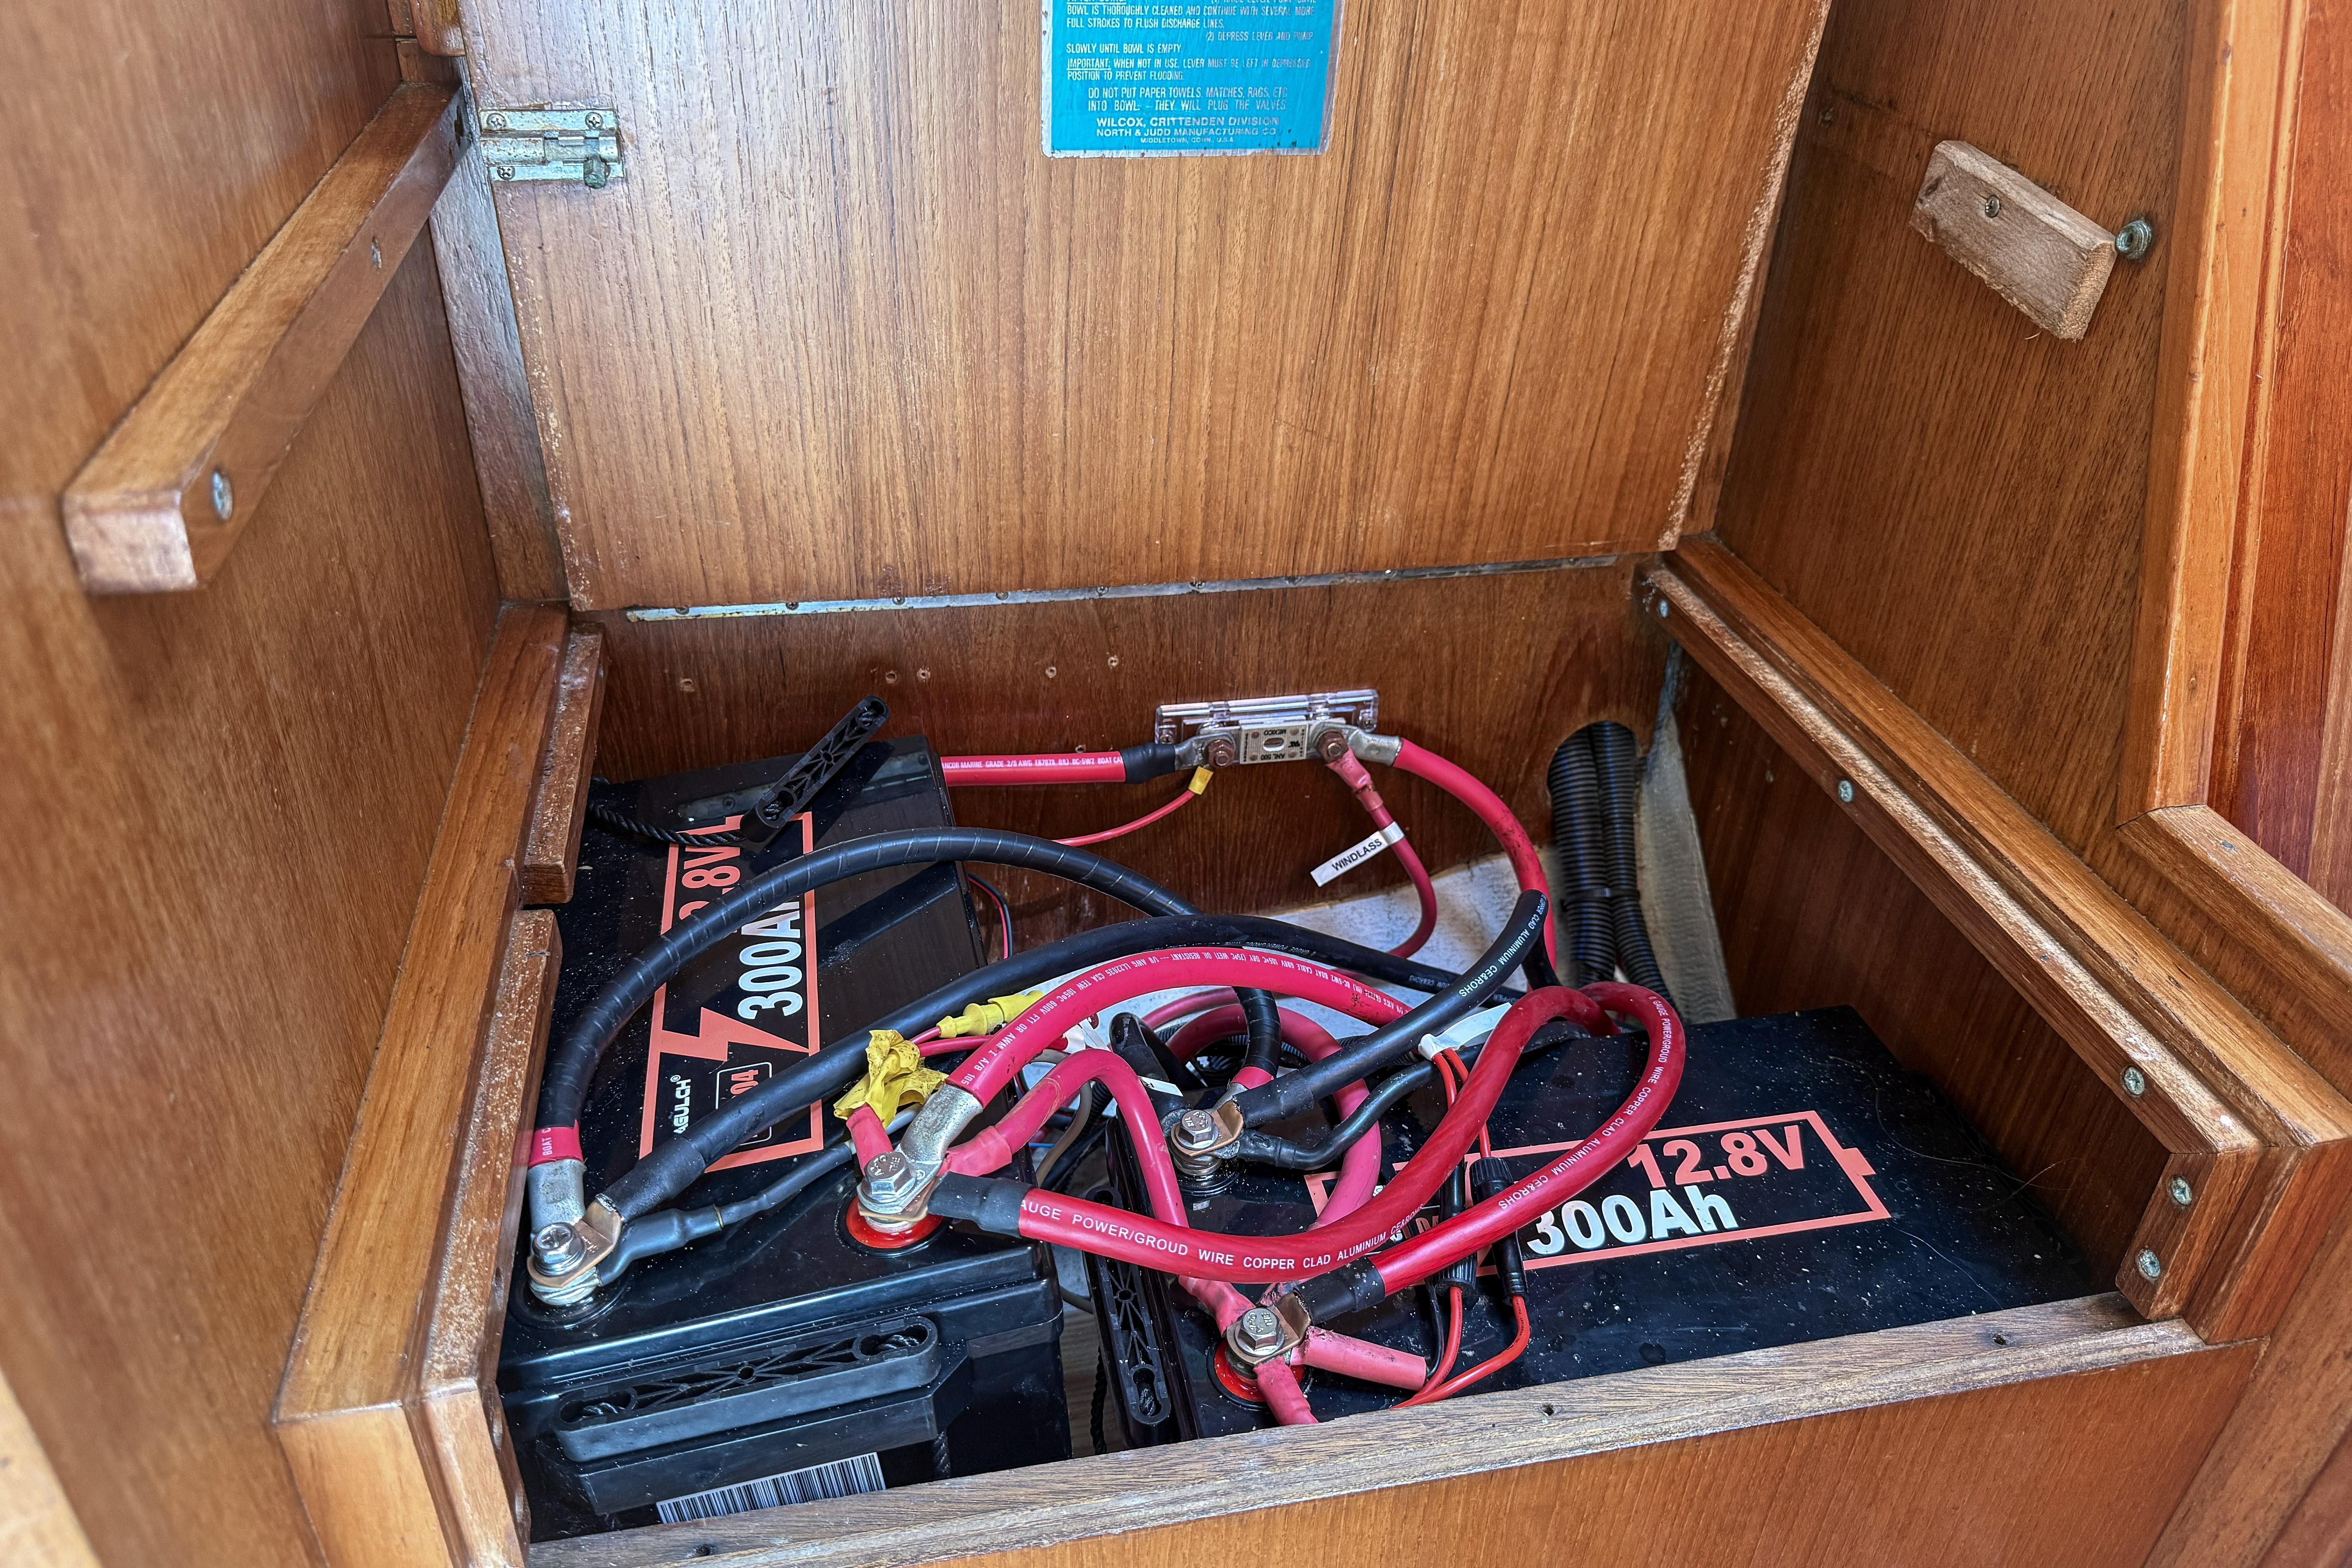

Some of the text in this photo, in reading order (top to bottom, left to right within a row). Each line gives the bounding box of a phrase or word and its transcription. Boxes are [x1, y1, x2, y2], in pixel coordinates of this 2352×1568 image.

[1067, 5, 1089, 15] BOWL
[1092, 5, 1099, 15] IS
[1103, 5, 1149, 15] THOROUGHLY
[1152, 5, 1183, 16] CLEANED
[1186, 6, 1200, 16] AND
[1203, 6, 1236, 16] CONTINUE
[1240, 6, 1258, 16] WITH
[1261, 6, 1290, 16] SEVERAL
[1067, 18, 1084, 28] FULL
[1087, 18, 1120, 28] STROKES
[1124, 18, 1132, 28] TO
[1135, 18, 1158, 28] FLUSH
[1162, 18, 1200, 28] DISCHARGE
[1206, 31, 1214, 42] (2)
[1218, 31, 1249, 41] DEPRESS
[1252, 31, 1273, 41] LEVER
[1276, 31, 1290, 41] AND
[1066, 43, 1096, 54] SLOWLY
[1099, 43, 1120, 54] UNTIL
[1123, 43, 1143, 54] BOWL
[1147, 43, 1154, 54] IS
[1067, 58, 1111, 69] IMPORTANT:
[1113, 58, 1134, 68] WHEN
[1137, 58, 1151, 68] NOT
[1154, 58, 1161, 68] IN
[1183, 58, 1205, 68] LEVER
[1208, 58, 1227, 68] MUST
[1231, 58, 1239, 68] BE
[1243, 58, 1258, 68] LEFT
[1067, 71, 1100, 81] POSITION
[1104, 71, 1112, 81] TO
[1115, 71, 1146, 81] PREVENT
[1088, 87, 1099, 98] DO
[1102, 87, 1118, 98] NOT
[1121, 87, 1137, 98] PUT
[1139, 87, 1166, 98] PAPER
[1088, 100, 1107, 111] INTO
[1155, 100, 1175, 111] THEY
[1181, 100, 1201, 111] WILL
[1208, 100, 1228, 110] PLUG
[1235, 99, 1249, 110] THE
[1256, 99, 1286, 110] VALVES
[1097, 117, 1279, 128] WILCOX, CRITTENDEN DIVISION
[1174, 128, 1258, 136] MANUFACTURING
[1331, 837, 1383, 872] WINDLASS
[1528, 914, 1540, 930] CLAD
[1498, 929, 1530, 965] ALUMINIUM
[738, 901, 803, 1020] 300A
[1170, 952, 1201, 961] RESISTANT
[1131, 959, 1147, 968] AWG
[1091, 972, 1105, 982] CSA
[1315, 969, 1329, 980] BOAT
[1459, 965, 1498, 997] CE&ROHS
[1076, 979, 1092, 991] TEW
[1039, 1000, 1058, 1015] 600V
[1652, 1000, 1668, 1017] GAUGE
[1026, 1013, 1041, 1024] FT1
[1015, 1023, 1028, 1034] OR
[996, 1032, 1016, 1050] AWM
[1658, 1018, 1671, 1063] POWER/GROUD
[961, 1073, 976, 1085] 105
[1647, 1066, 1664, 1084] WIRE
[1623, 1087, 1652, 1115] COPPER
[1602, 1117, 1625, 1136] CLAD
[541, 1137, 553, 1156] BOAT
[1551, 1137, 1601, 1176] ALUMINIUM
[1627, 1125, 1804, 1188] 12.8V
[1498, 1175, 1549, 1210] CE&ROHS
[1527, 1185, 1739, 1255] 300Ah
[1071, 1213, 1189, 1256] POWER/GROUD
[1198, 1248, 1235, 1266] WIRE
[1243, 1256, 1295, 1269] COPPER
[1302, 1254, 1331, 1269] CLAD
[1337, 1231, 1387, 1262] ALUMINIUM
